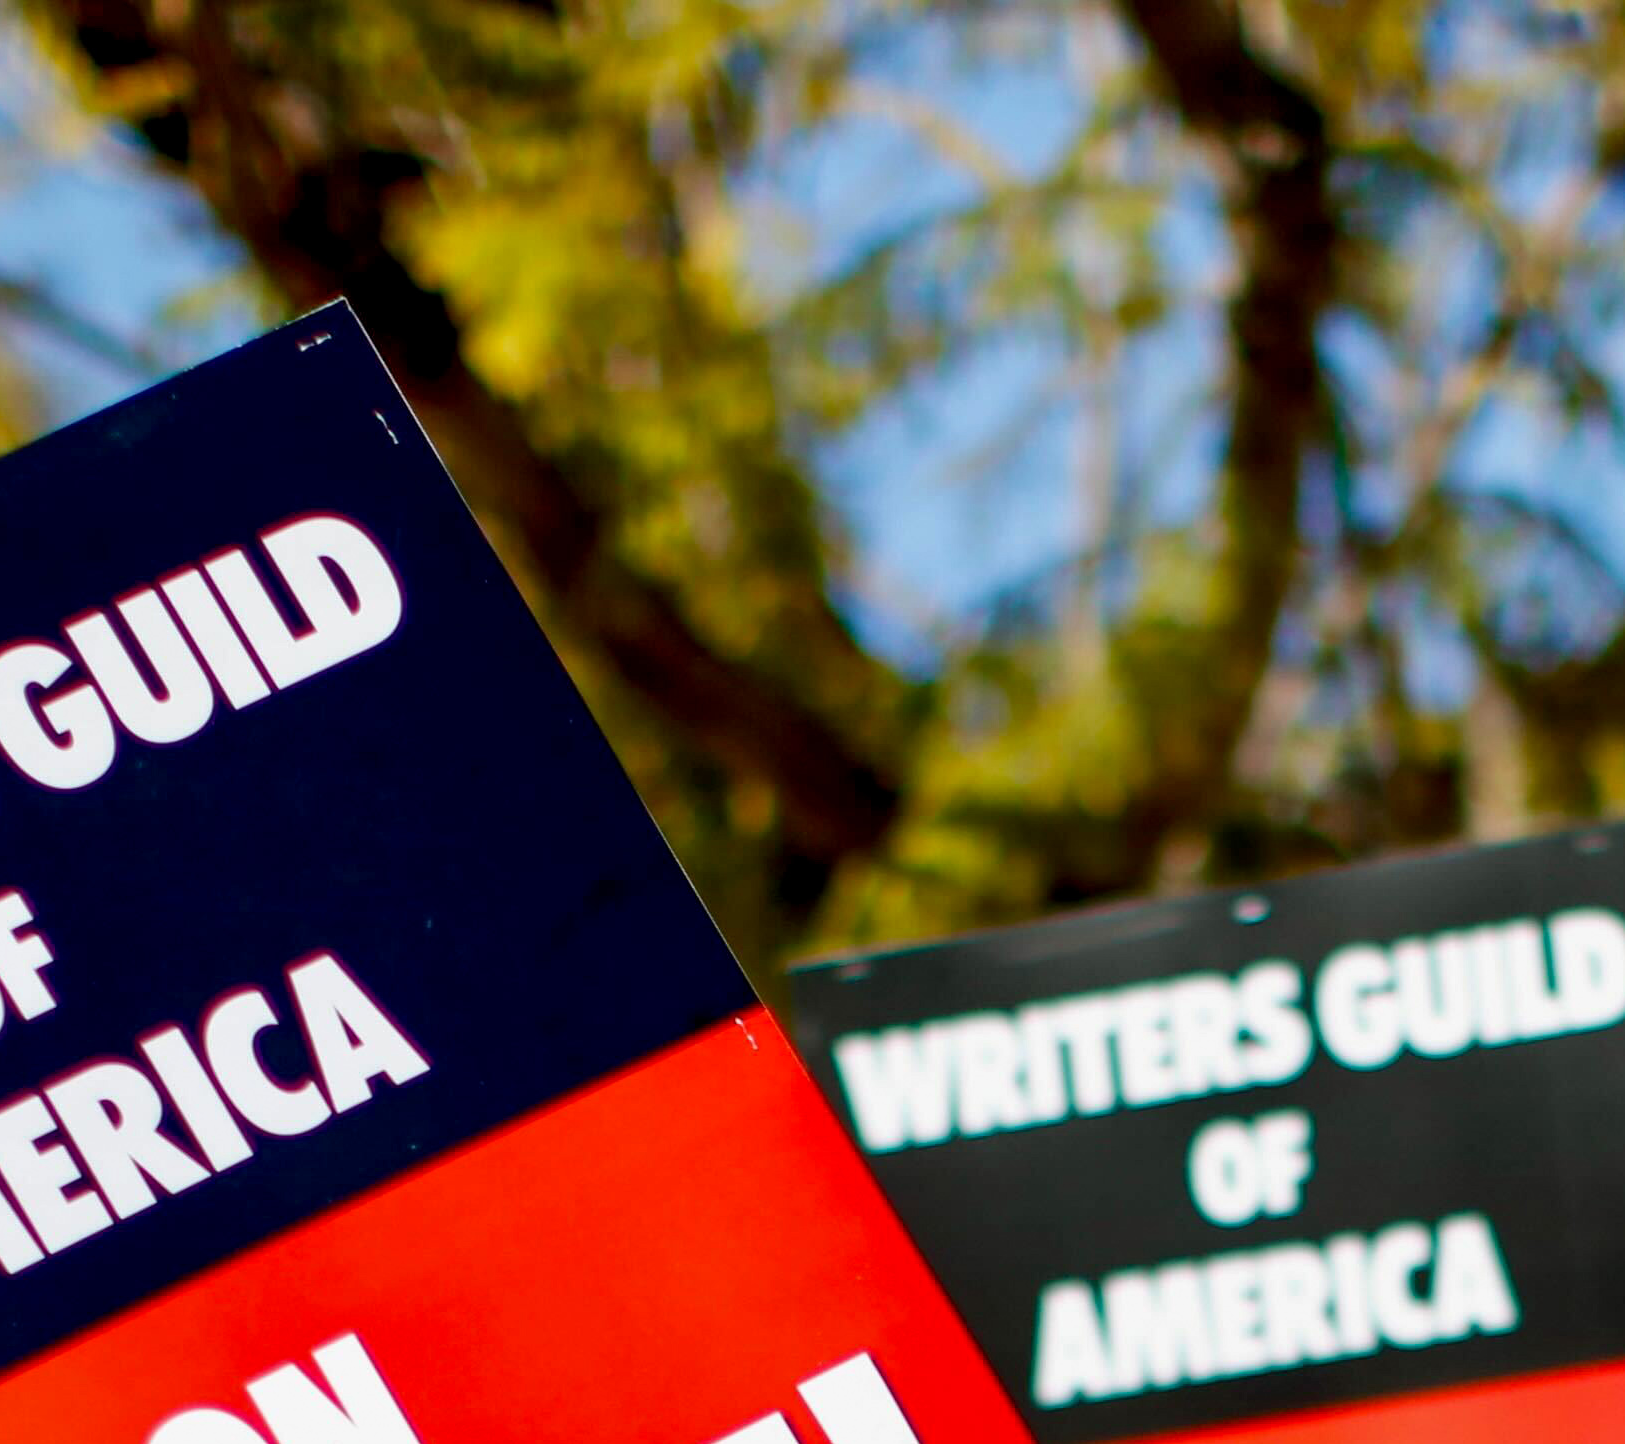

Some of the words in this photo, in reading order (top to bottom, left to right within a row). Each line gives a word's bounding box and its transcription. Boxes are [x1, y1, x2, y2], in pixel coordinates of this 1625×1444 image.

[832, 959, 1315, 1154] WRITERS
[1187, 1109, 1313, 1225] OF
[1032, 1212, 1518, 1407] AMERICA
